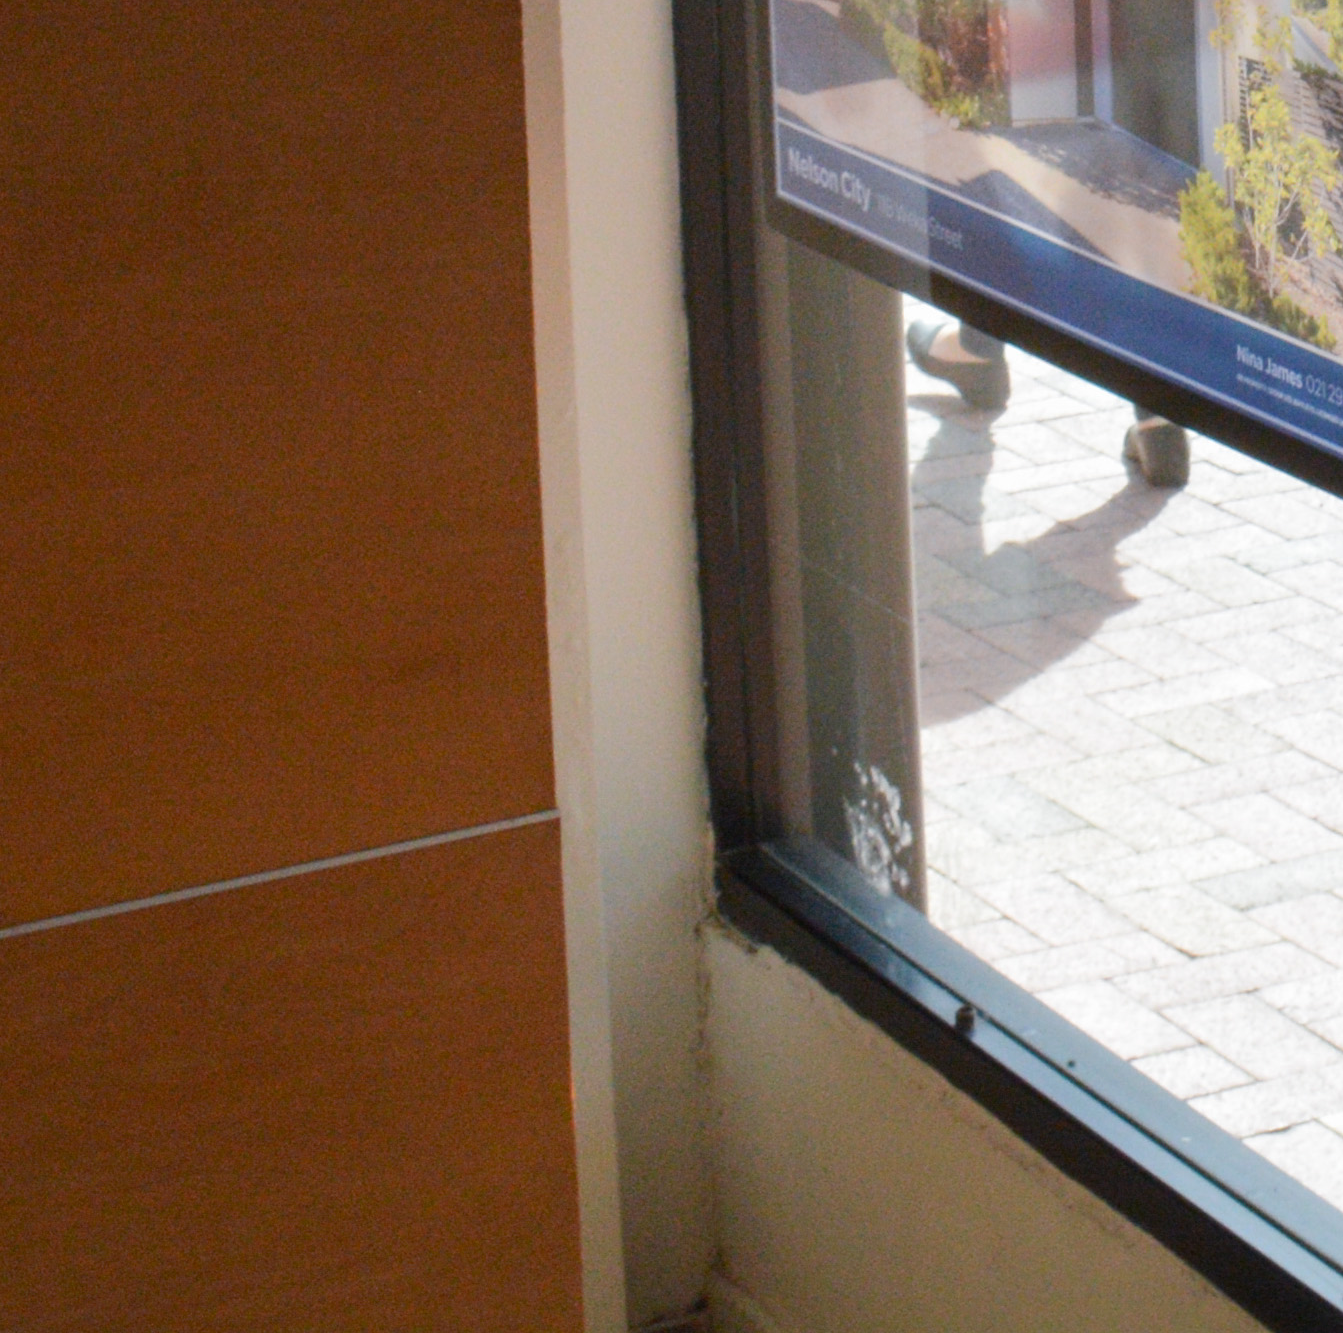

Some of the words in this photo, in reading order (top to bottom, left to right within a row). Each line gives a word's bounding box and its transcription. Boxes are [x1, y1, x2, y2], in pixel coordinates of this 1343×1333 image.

[787, 147, 839, 194] Nelson
[840, 170, 871, 212] City
[1236, 344, 1263, 372] Nina
[1264, 356, 1303, 390] James
[1306, 374, 1327, 399] 021
